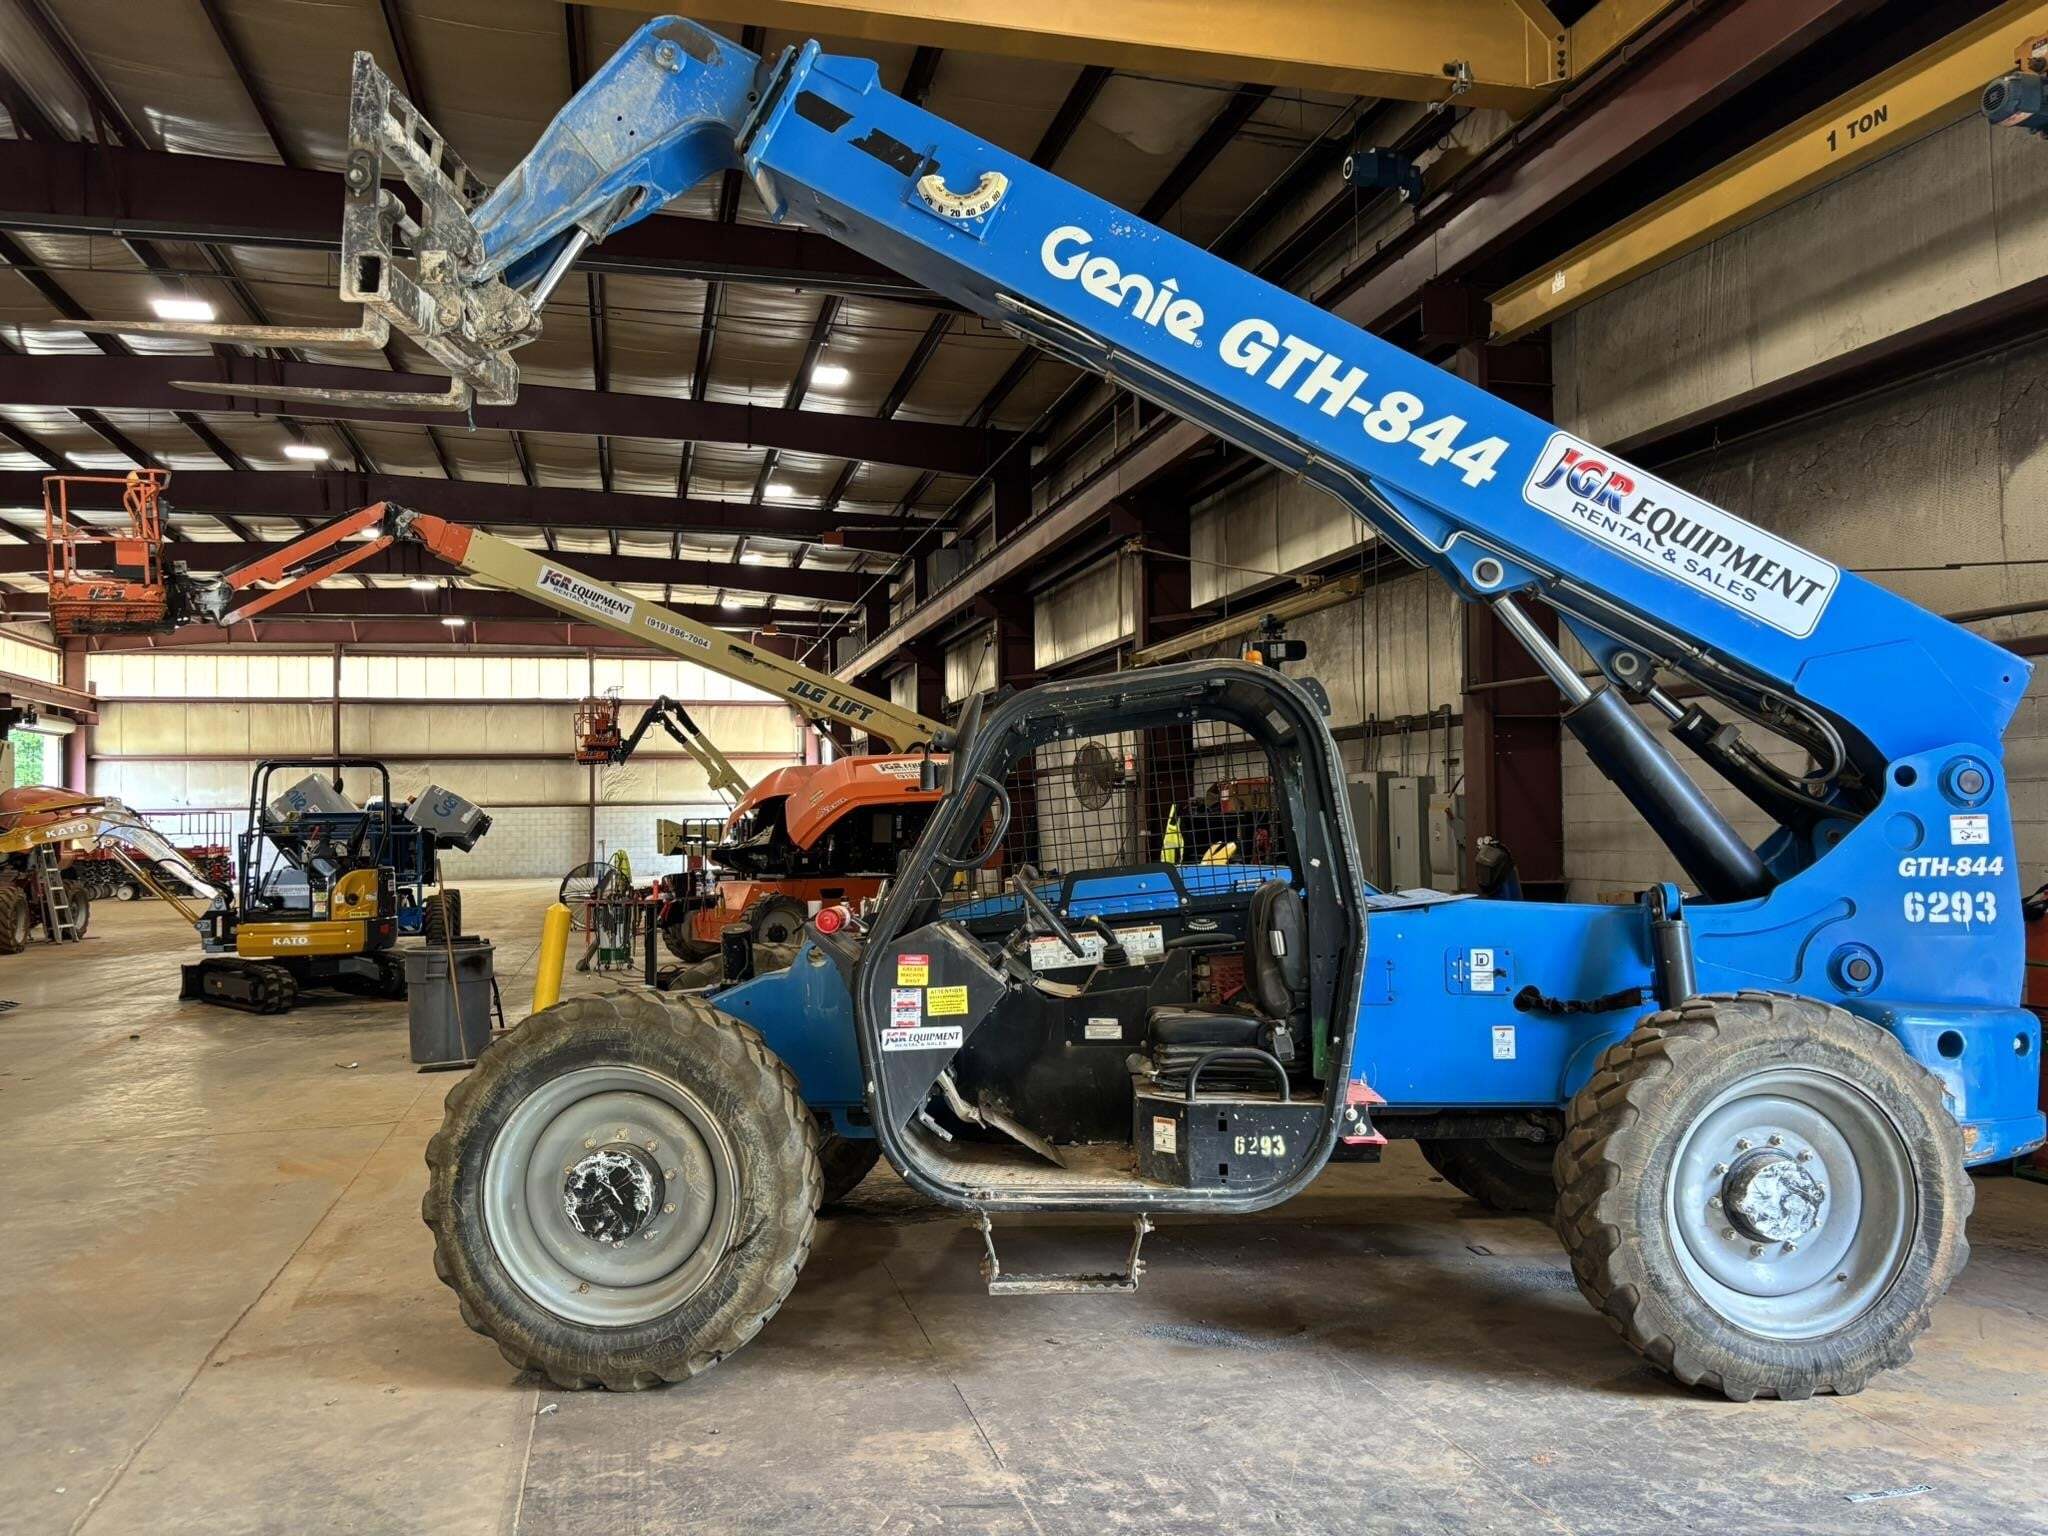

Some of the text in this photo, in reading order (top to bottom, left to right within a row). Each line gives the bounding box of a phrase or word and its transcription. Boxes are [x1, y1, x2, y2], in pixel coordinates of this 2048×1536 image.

[1826, 104, 1888, 152] 1 TON
[937, 204, 944, 214] 0
[950, 208, 961, 217] 20
[965, 208, 977, 217] 40
[979, 201, 991, 211] 60
[1041, 226, 1510, 488] Genie GTH-844
[1535, 447, 1826, 606] JGR EQUIPMENT
[1571, 501, 1758, 602] RENTAL & SALES
[541, 569, 633, 615] JGR EQUIPMENT
[553, 586, 582, 602] RENTAL
[590, 602, 615, 616] SALES
[647, 617, 709, 648] (919) 896-7004
[786, 680, 874, 721] JLG LIFT
[45, 822, 90, 839] KATO
[1898, 856, 2004, 877] GTH-844
[1903, 890, 1998, 924] 6293
[272, 936, 309, 946] KATO
[930, 987, 964, 995] ATTENTION
[908, 1031, 961, 1044] EQUIPMENT
[1234, 1134, 1287, 1157] 6293
